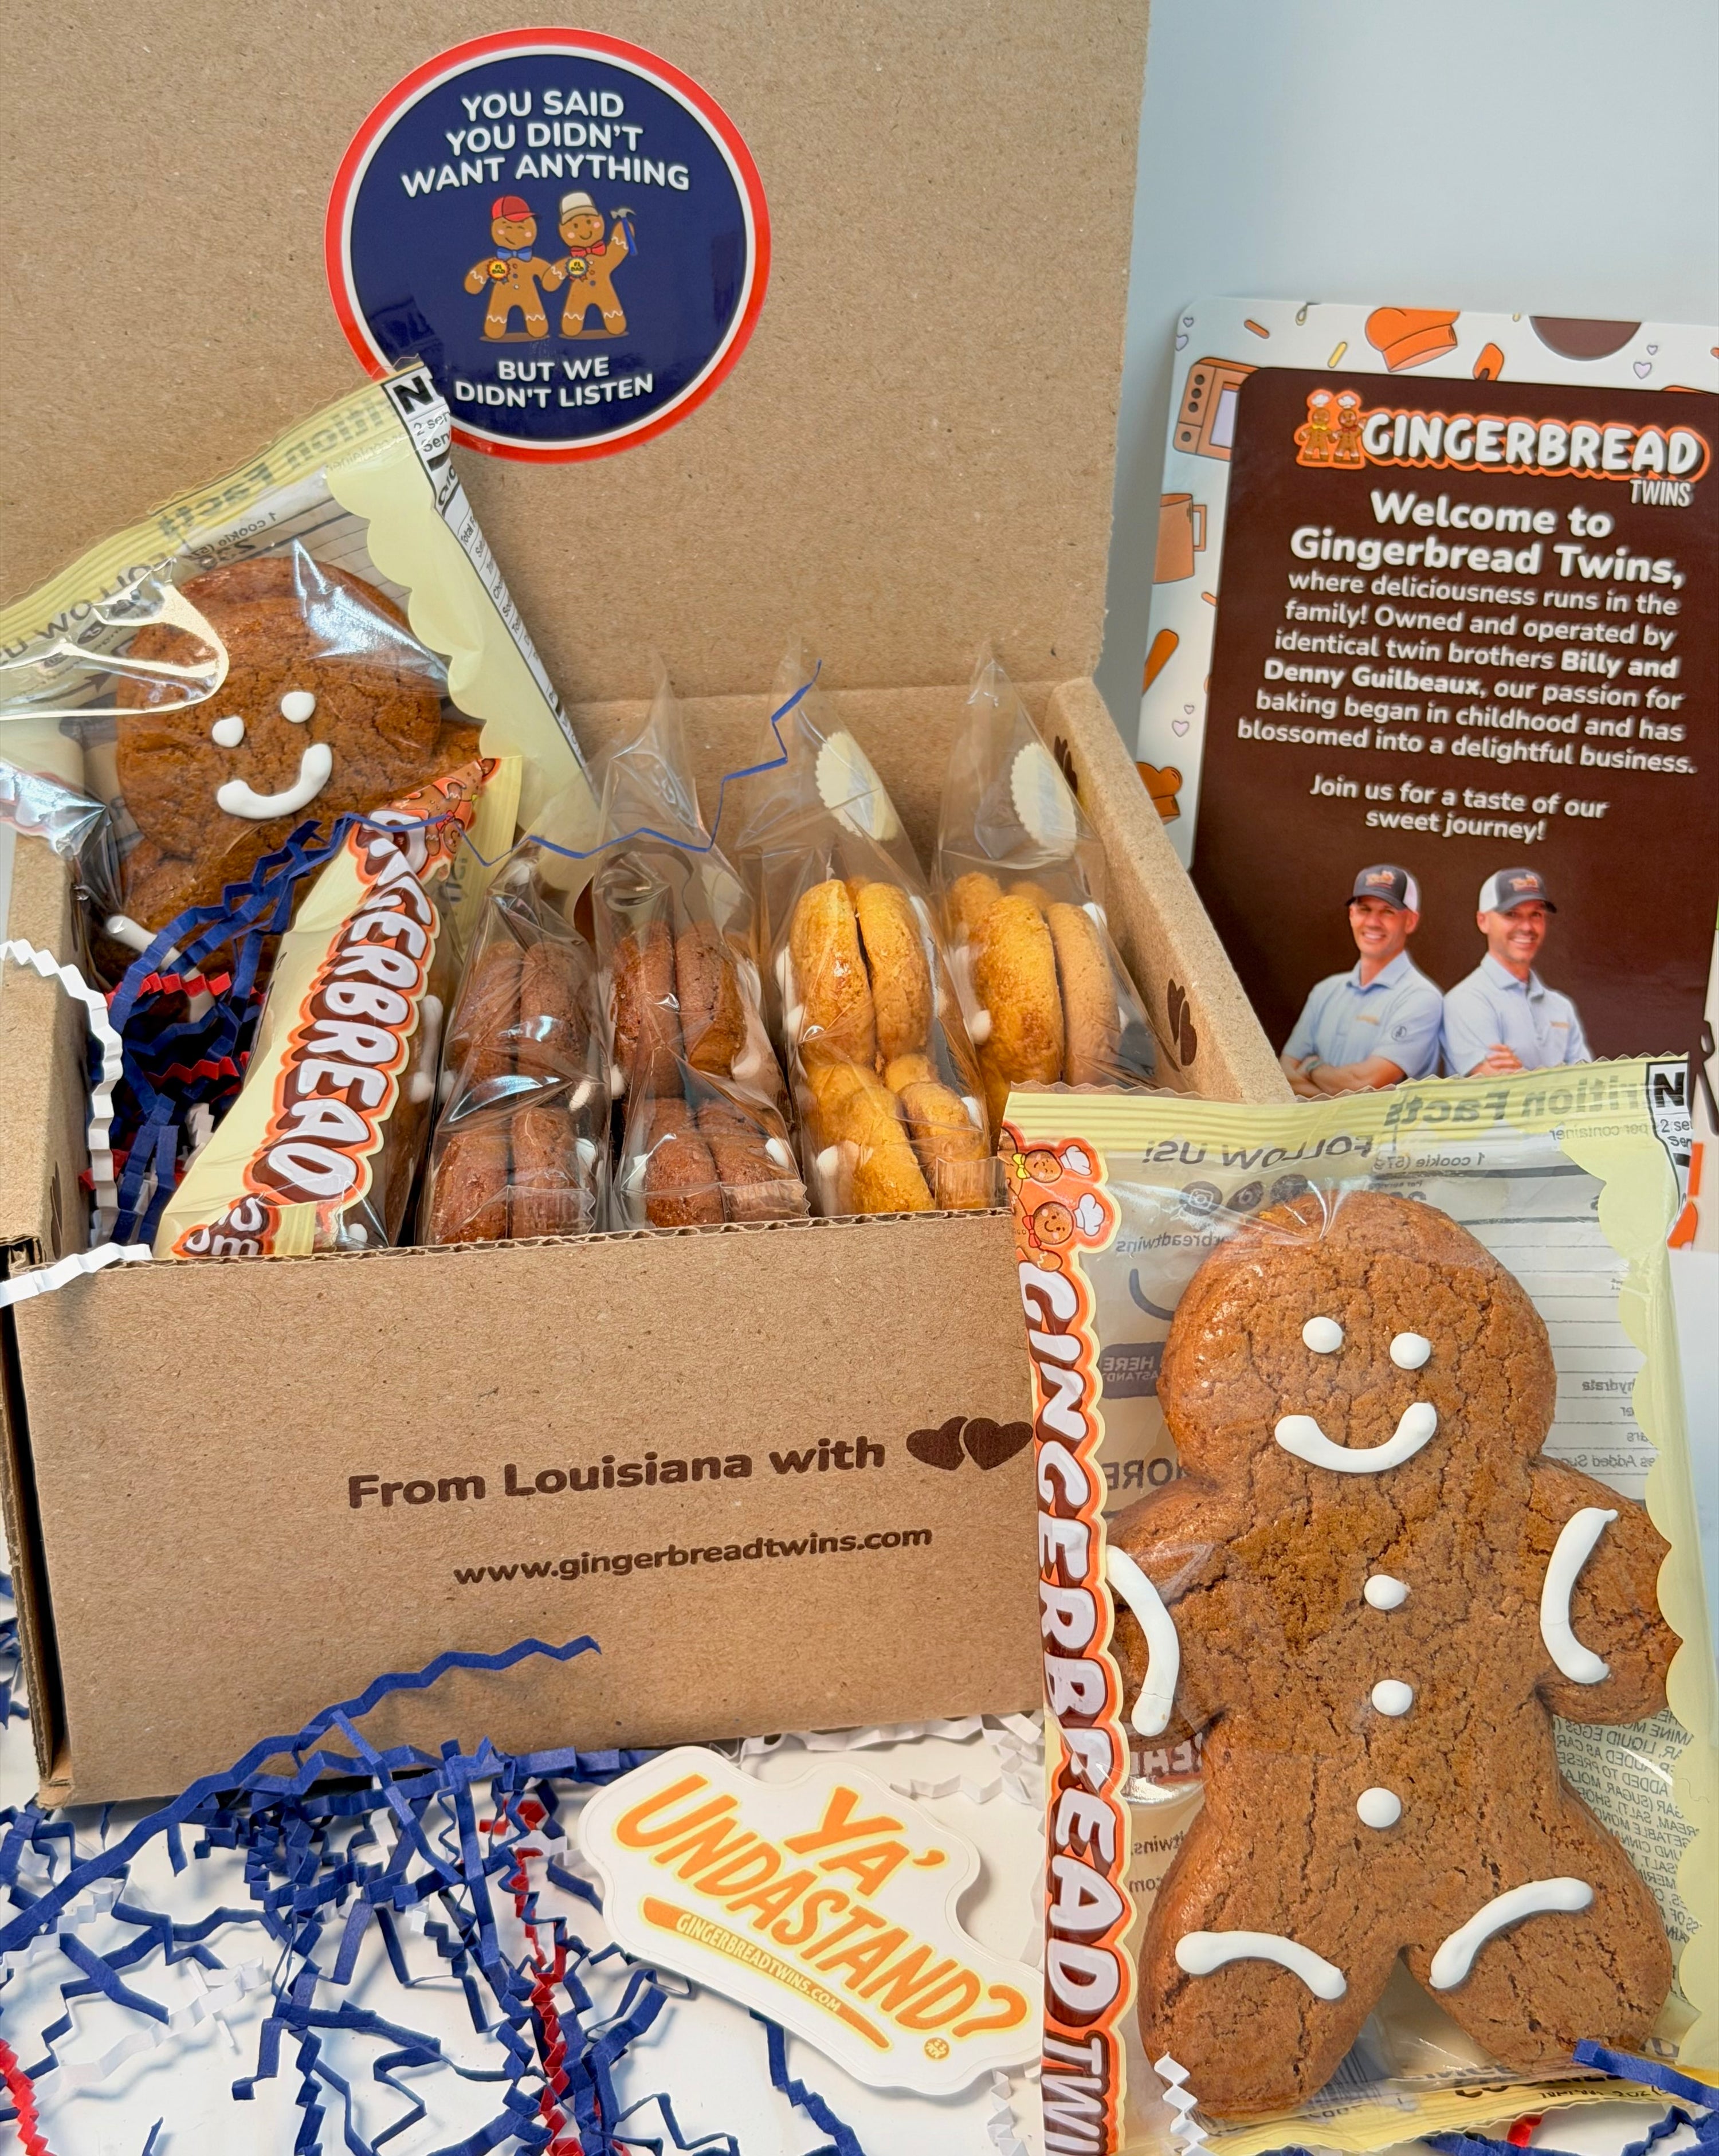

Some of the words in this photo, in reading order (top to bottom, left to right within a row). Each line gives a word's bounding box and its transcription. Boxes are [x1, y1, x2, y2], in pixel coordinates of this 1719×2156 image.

[461, 91, 532, 121] YOU
[543, 90, 624, 117] SAID
[446, 124, 516, 156] YOU
[527, 121, 643, 151] DIDN'T
[401, 156, 505, 197] WANT
[515, 153, 689, 190] ANYTHING
[455, 381, 552, 408] DIDN'T
[560, 373, 653, 407] LISTEN
[499, 360, 555, 382] BUT
[563, 356, 609, 380] WE
[1358, 413, 1699, 474] GINGERBREAD
[1371, 491, 1556, 534] Welcome
[1568, 507, 1612, 538] to
[1630, 479, 1691, 507] TWINS
[1291, 527, 1541, 575] Gingerbread
[1553, 544, 1683, 589] Twins,
[1289, 570, 1364, 593] where
[1371, 575, 1536, 606] deliciousness
[1543, 591, 1598, 610] runs
[1606, 590, 1628, 612] in
[1636, 593, 1678, 616] the
[1285, 599, 1368, 628] family!
[1375, 605, 1463, 632] Owned
[1470, 615, 1517, 635] and
[1523, 622, 1636, 644] operated
[1643, 625, 1674, 651] by
[1275, 629, 1379, 657] identical
[1386, 640, 1441, 661] twin
[1448, 642, 1553, 669] brothers
[1561, 650, 1622, 679] Billy
[1628, 658, 1679, 679] and
[1265, 659, 1345, 689] Denny
[1352, 666, 1486, 698] Guilbeaux,
[1494, 682, 1537, 699] our
[1543, 684, 1638, 707] passion
[1646, 688, 1683, 709] for
[1257, 689, 1337, 719] baking
[1344, 696, 1419, 723] began
[1427, 702, 1449, 723] in
[1456, 705, 1579, 733] childhood
[1584, 718, 1633, 738] and
[1639, 719, 1683, 742] has
[1238, 718, 1369, 748] blossomed
[1376, 729, 1423, 752] into
[1430, 739, 1444, 754] a
[1451, 736, 1572, 765] delightful
[1580, 745, 1694, 774] business.
[1310, 775, 1357, 798] Join
[1365, 785, 1392, 801] us
[1400, 782, 1435, 803] for
[1441, 791, 1456, 806] a
[1463, 789, 1525, 812] taste
[1532, 794, 1560, 814] of
[1564, 801, 1607, 818] our
[1366, 812, 1439, 832] sweet
[1443, 813, 1544, 844] journey!
[348, 1475, 486, 1509] From
[504, 1452, 752, 1497] Louisiana
[768, 1436, 885, 1475] with
[453, 1528, 932, 1585] www.gingerbreadtwins.com
[1019, 1260, 1123, 2013] GINGERBREAD
[616, 1775, 1027, 2060] UNDASTAND?
[676, 1913, 841, 2013] GINGERBREADTWINS.COM
[1041, 2037, 1103, 2155] TWI
